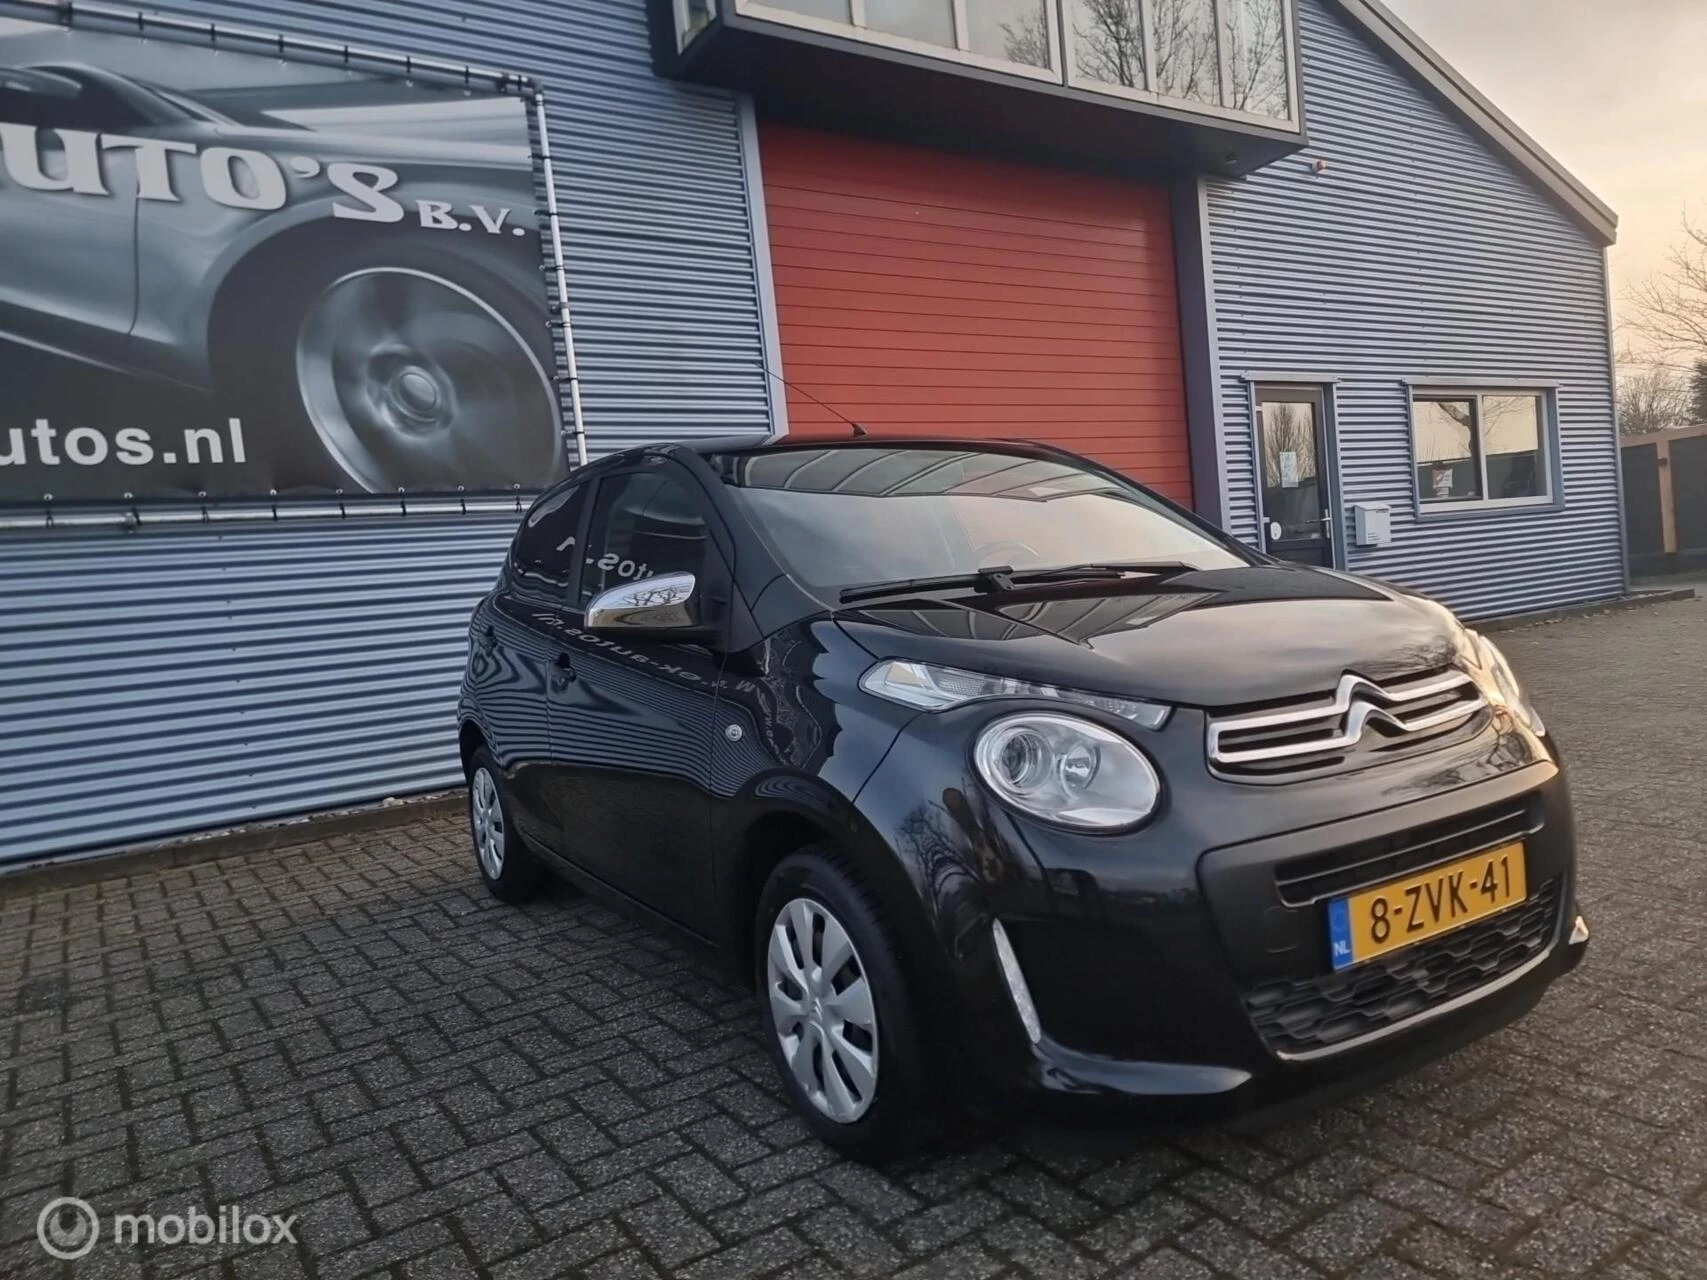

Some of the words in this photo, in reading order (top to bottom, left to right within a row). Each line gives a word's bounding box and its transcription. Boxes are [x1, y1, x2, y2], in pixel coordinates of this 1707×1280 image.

[415, 200, 525, 237] B.V.
[1371, 856, 1510, 944] 8-ZVK-41
[1334, 940, 1350, 957] NL
